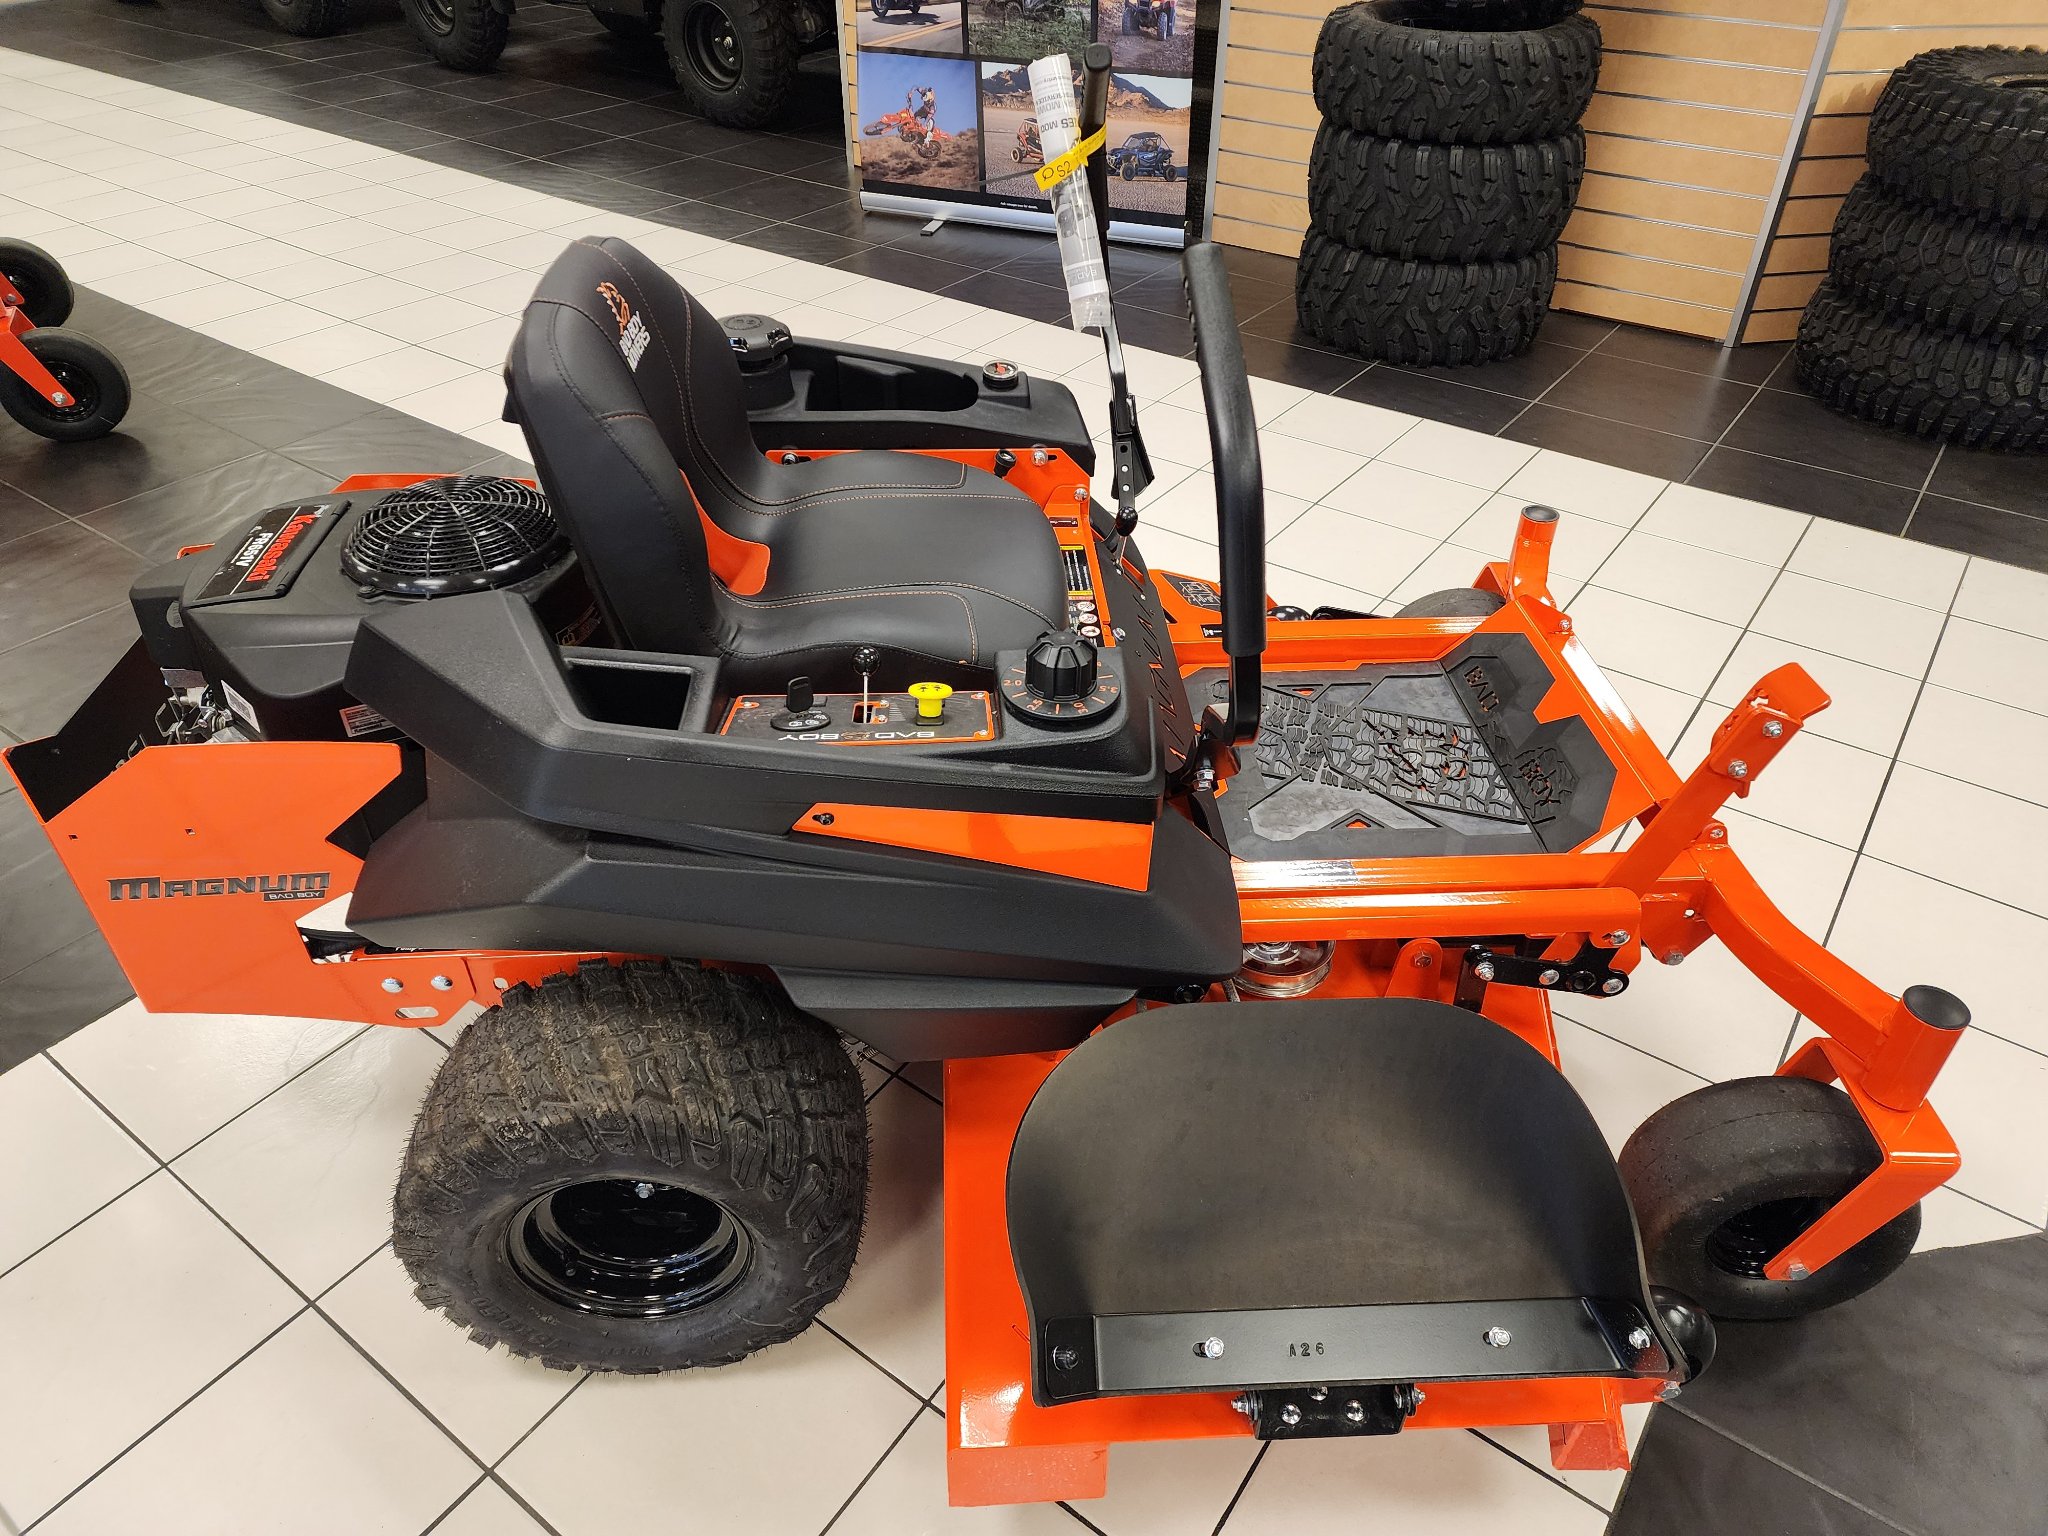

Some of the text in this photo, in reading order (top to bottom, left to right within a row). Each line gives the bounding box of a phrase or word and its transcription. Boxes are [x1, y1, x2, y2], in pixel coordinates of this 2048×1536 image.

[236, 532, 274, 567] FR651V
[246, 514, 316, 582] Kawasaki
[1464, 666, 1499, 712] BAD
[778, 731, 935, 741] BAD BOY
[106, 871, 331, 900] MAGNUM
[268, 891, 322, 899] BAD BOY
